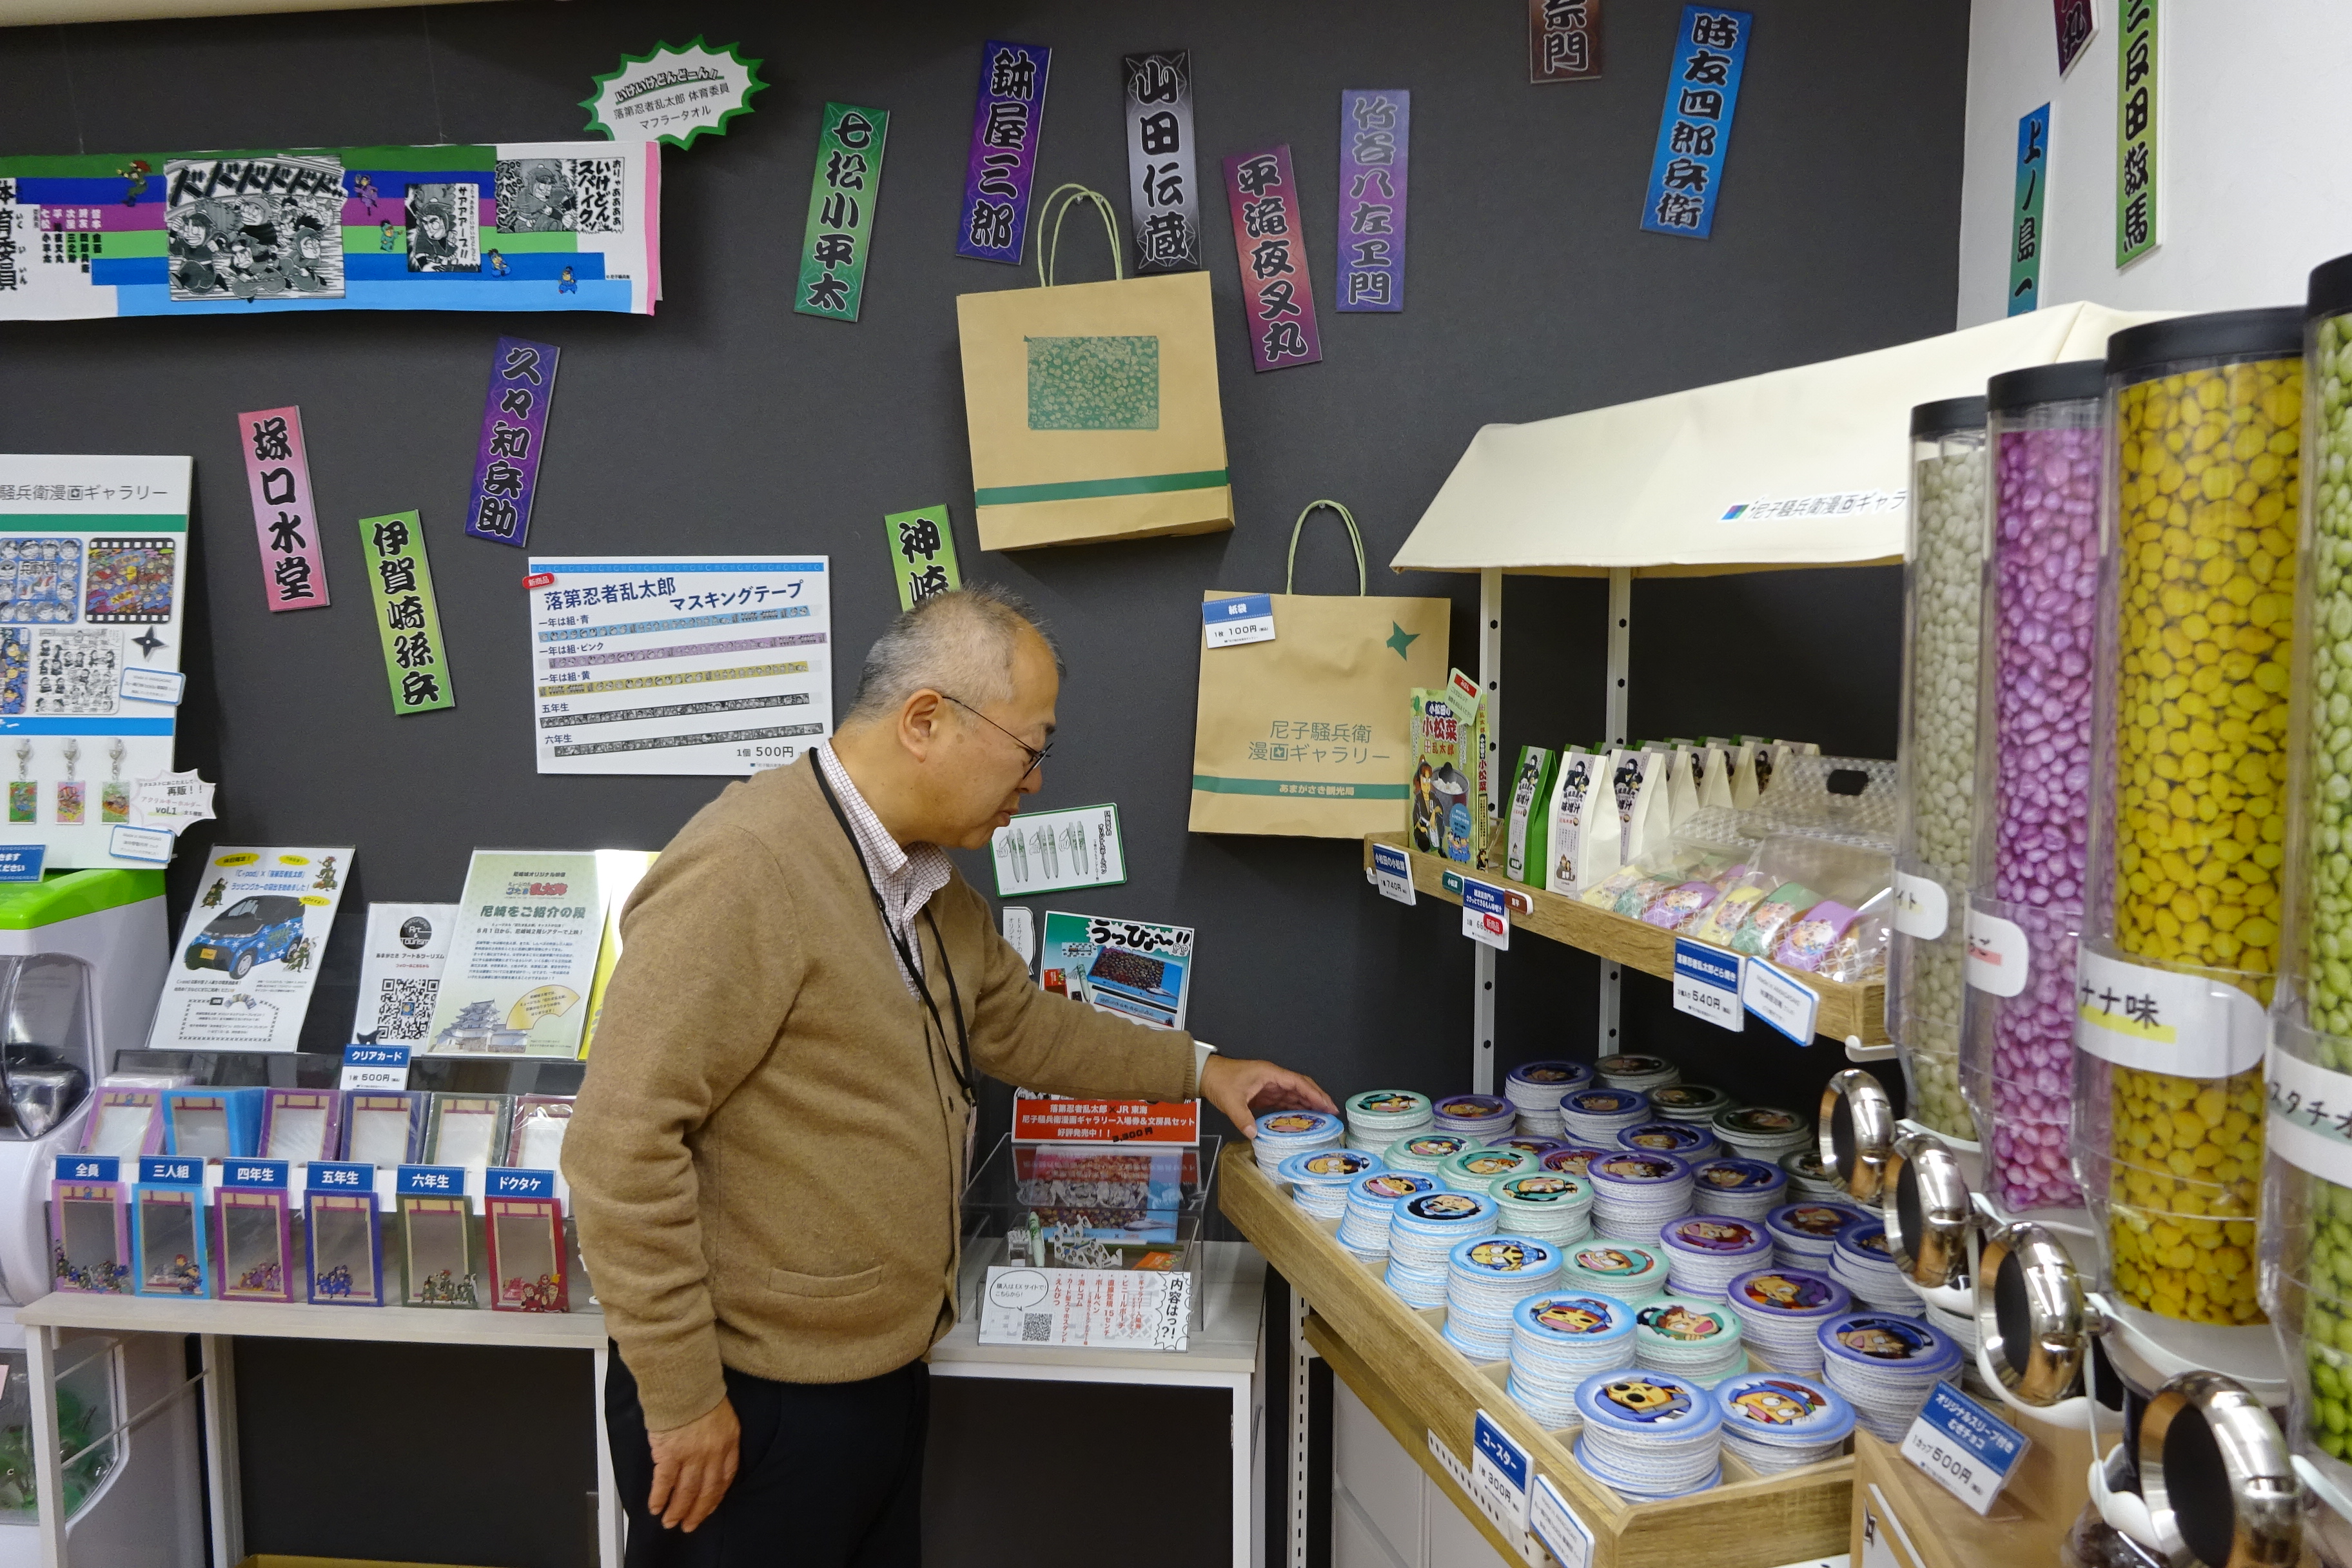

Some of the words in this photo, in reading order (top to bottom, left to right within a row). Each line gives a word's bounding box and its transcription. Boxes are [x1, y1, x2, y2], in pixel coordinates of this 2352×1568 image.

[613, 93, 686, 121] 落第忍者乱太郎
[688, 82, 730, 103] 体育委員
[639, 106, 712, 130] マフラータオル
[1655, 12, 1740, 230] 時友四郎兵衛
[969, 47, 1037, 250] 鉢屋三郎
[1135, 60, 1189, 262] 山田伝蔵
[596, 160, 612, 224] いけどん
[807, 111, 873, 312] 七松小平太
[1237, 153, 1308, 362] 平滝夜叉丸
[253, 416, 316, 602] 塚口水堂
[527, 575, 551, 587] 新商品
[544, 576, 676, 612] 落第忍者乱太郎
[669, 579, 804, 612] マスキングテープ
[372, 519, 441, 708] 伊賀崎孫兵
[1228, 603, 1248, 616] 紙袋
[1228, 625, 1257, 636] 100円
[542, 702, 569, 714] 五年生
[544, 733, 573, 745] 六年生
[1269, 720, 1373, 744] 尼子騒兵衛
[1422, 716, 1458, 743] 小松菜
[737, 749, 751, 757] 1個
[756, 746, 794, 758] 500円
[1247, 740, 1391, 764] 漫画ギャラリー
[1432, 742, 1455, 756] 乱太郎
[1478, 759, 1487, 792] 小松菜
[1279, 783, 1355, 797] あまがさき観光局
[155, 806, 177, 816] vol.1
[1386, 879, 1402, 892] 740円
[480, 905, 587, 919] 尼崎をご紹介の段
[1692, 990, 1721, 1010] 540円
[351, 1050, 403, 1062] クリアカード
[362, 1073, 390, 1082] 500円
[1131, 1104, 1148, 1115] 東海
[75, 1163, 101, 1178] 全員
[152, 1164, 190, 1179] 三人組
[236, 1167, 275, 1182] 四年生
[321, 1170, 359, 1185] 五年生
[411, 1173, 450, 1190] 六年生
[498, 1176, 542, 1191] ドクタケ
[1053, 1279, 1063, 1306] えんぴつ
[1935, 1393, 2015, 1454] オリジナルスリーブ付き
[1482, 1431, 1518, 1470] コースター
[1931, 1446, 1973, 1484] 500円
[1488, 1471, 1511, 1504] 300円
